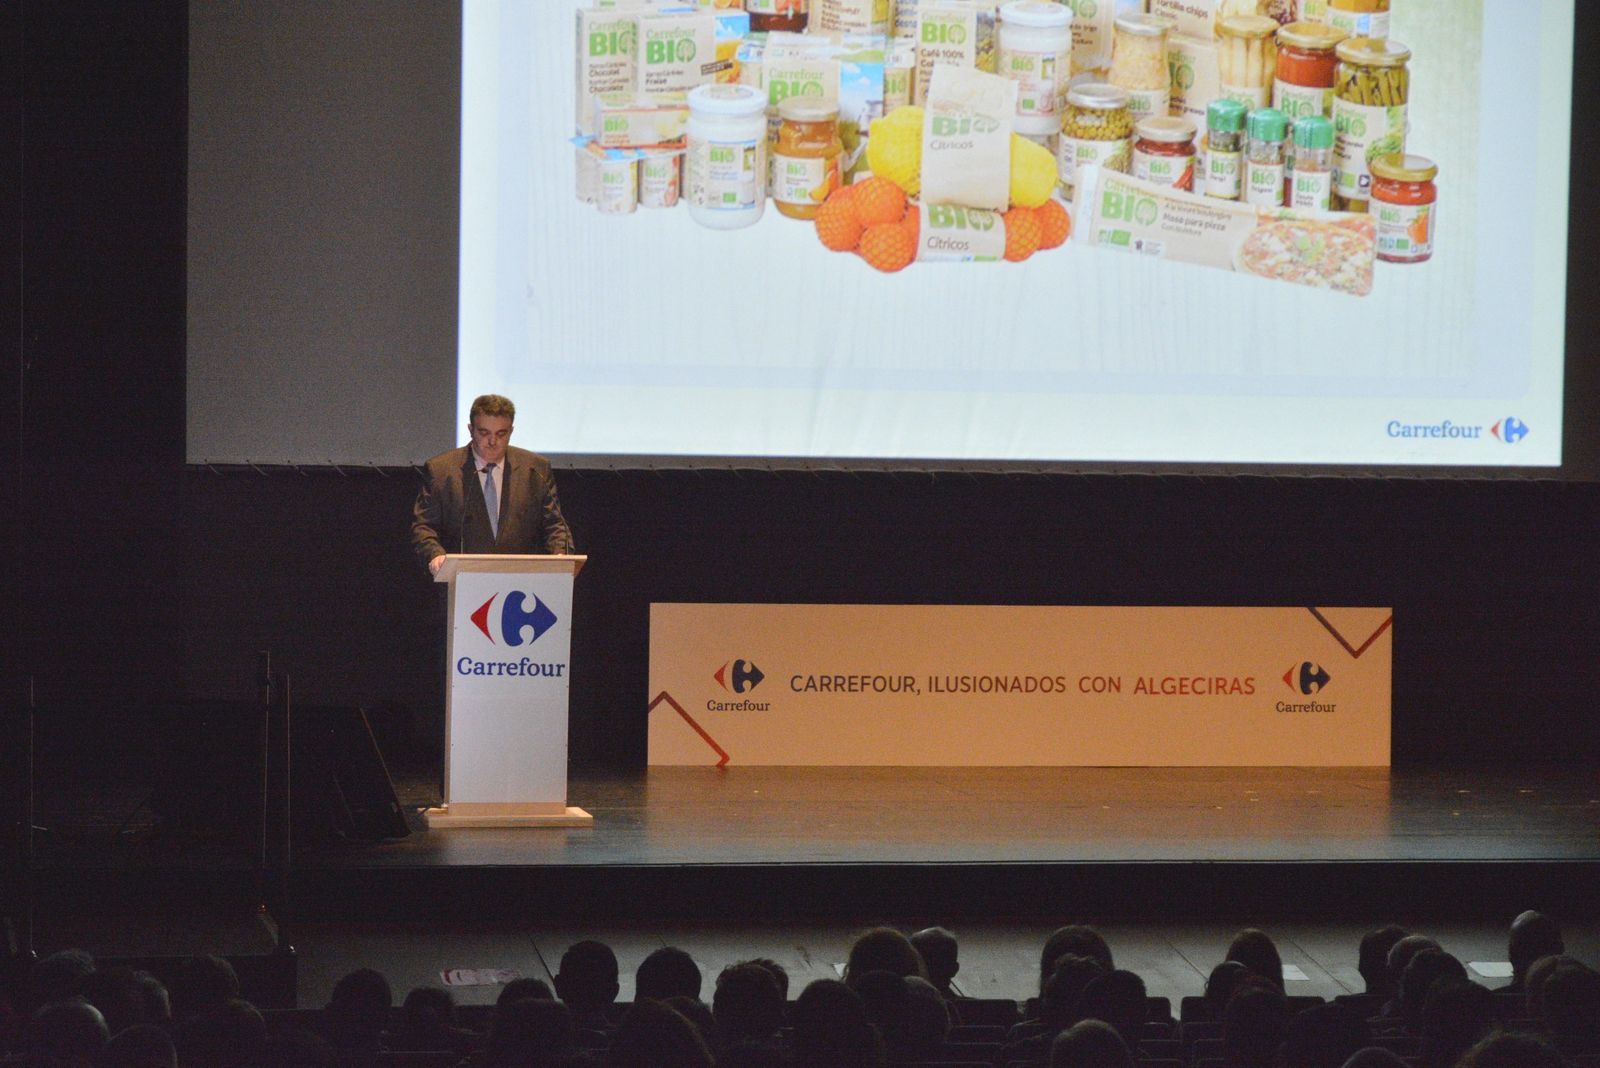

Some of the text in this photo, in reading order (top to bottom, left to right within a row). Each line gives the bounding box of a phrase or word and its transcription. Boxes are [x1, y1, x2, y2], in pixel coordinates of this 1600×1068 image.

[921, 22, 966, 45] BIO
[646, 38, 697, 64] BIO
[769, 68, 824, 80] Carrefour
[931, 113, 1000, 136] BIO
[1335, 112, 1368, 138] BIO
[710, 147, 734, 162] BIO
[1211, 160, 1236, 175] BIO
[1251, 168, 1276, 185] BIO
[927, 204, 994, 231] BIO
[1102, 191, 1158, 226] BIO
[1387, 420, 1482, 438] Carrefour
[457, 657, 565, 677] Carrefour
[790, 675, 1255, 695] CARREFOUR, ILUSIONADOS CON ALGECIRAS
[707, 700, 770, 712] Carrefour
[1276, 702, 1336, 713] Carrefour
